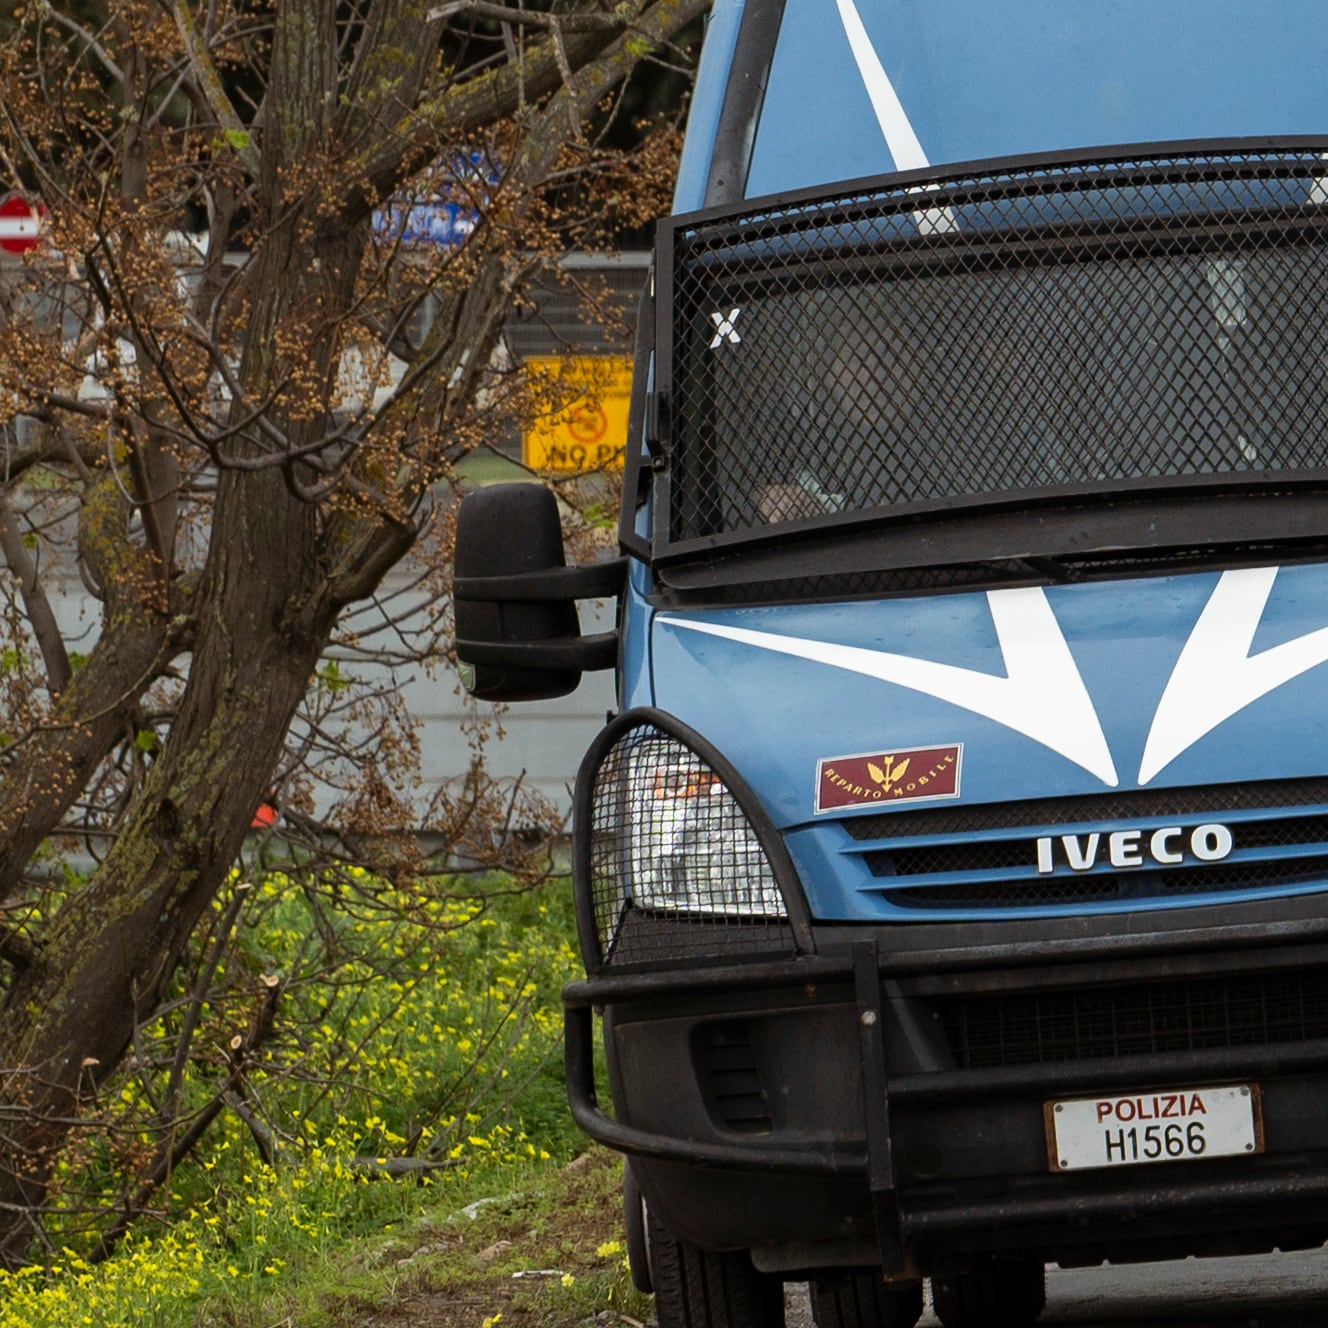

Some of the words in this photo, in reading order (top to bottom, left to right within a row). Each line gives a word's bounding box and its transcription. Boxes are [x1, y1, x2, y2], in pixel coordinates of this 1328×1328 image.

[824, 768, 882, 799] REPARTO
[893, 754, 954, 797] MOBILE
[1036, 823, 1233, 874] IVECO
[1096, 1093, 1207, 1123] POLIZIA
[1105, 1122, 1206, 1162] H1566
